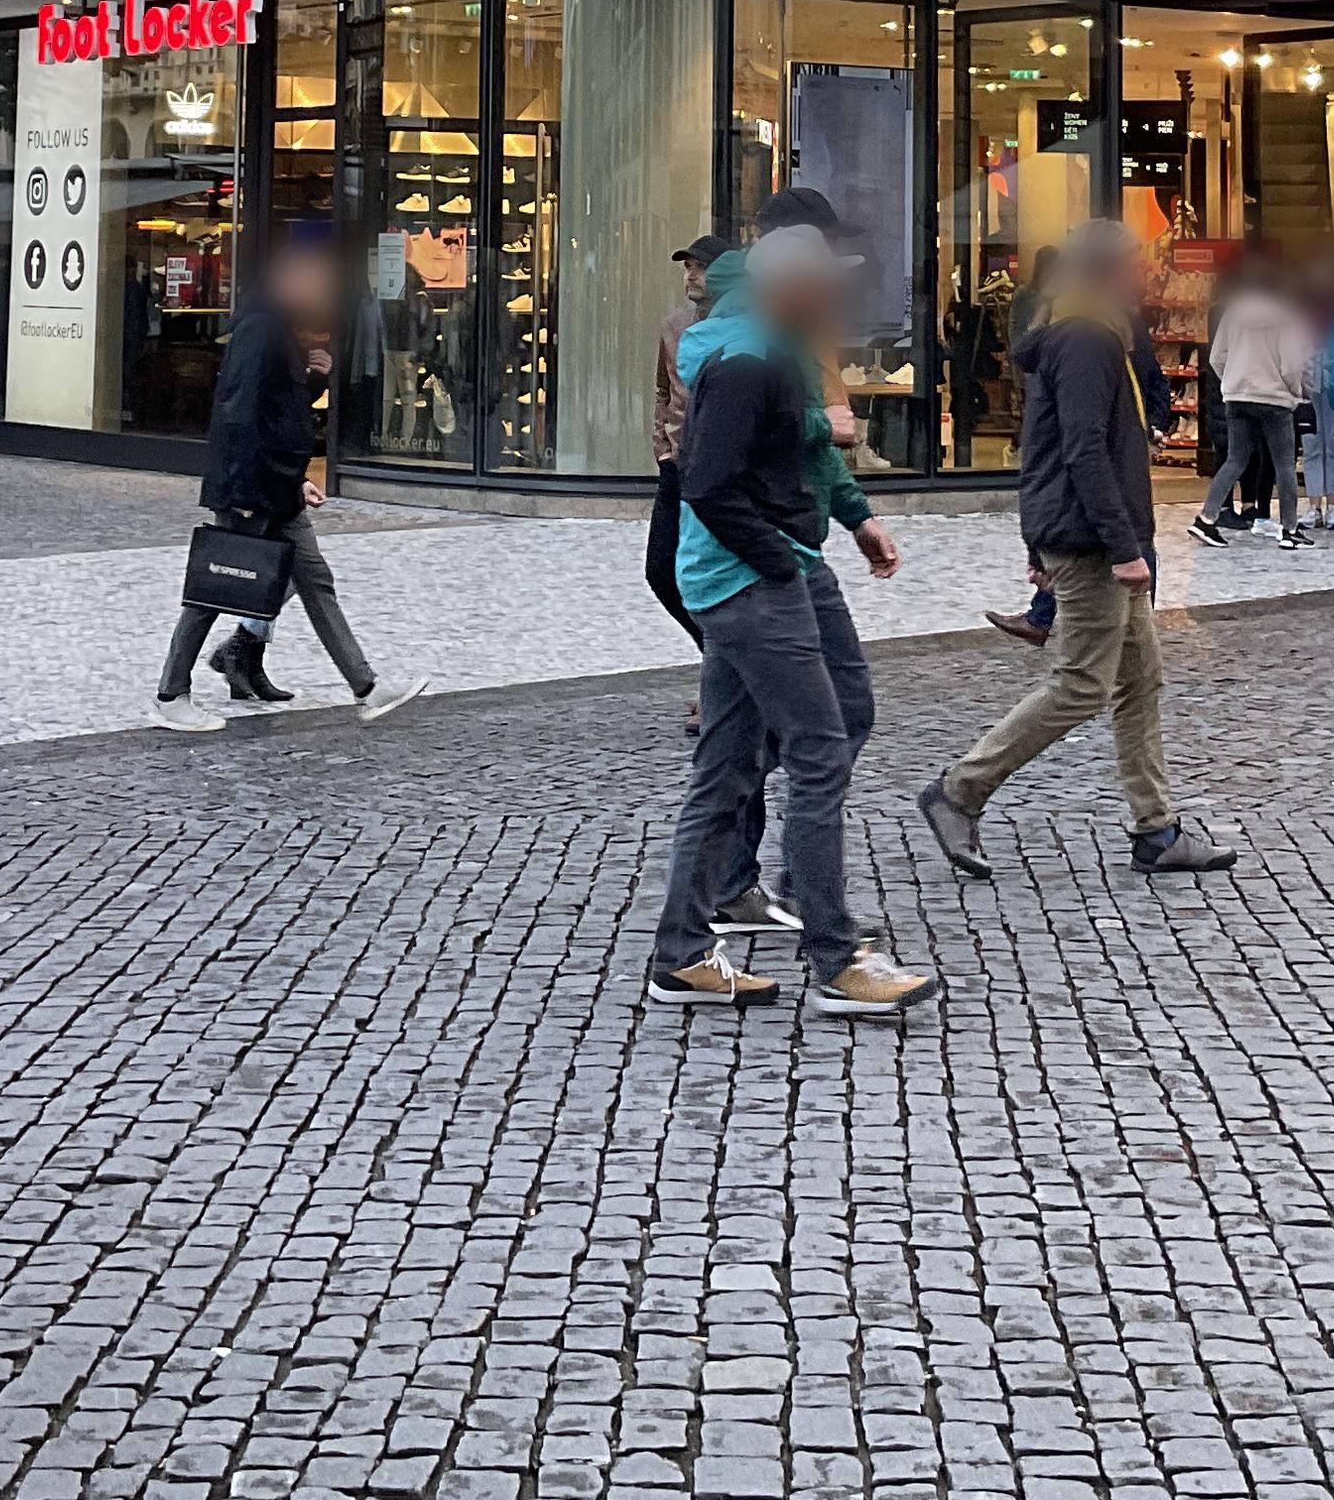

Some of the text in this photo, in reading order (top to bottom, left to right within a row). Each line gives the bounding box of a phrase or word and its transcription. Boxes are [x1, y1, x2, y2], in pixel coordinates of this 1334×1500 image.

[38, 0, 117, 65] Foot
[27, 128, 89, 149] FOLLOW US
[21, 320, 83, 339] @footlockerEU
